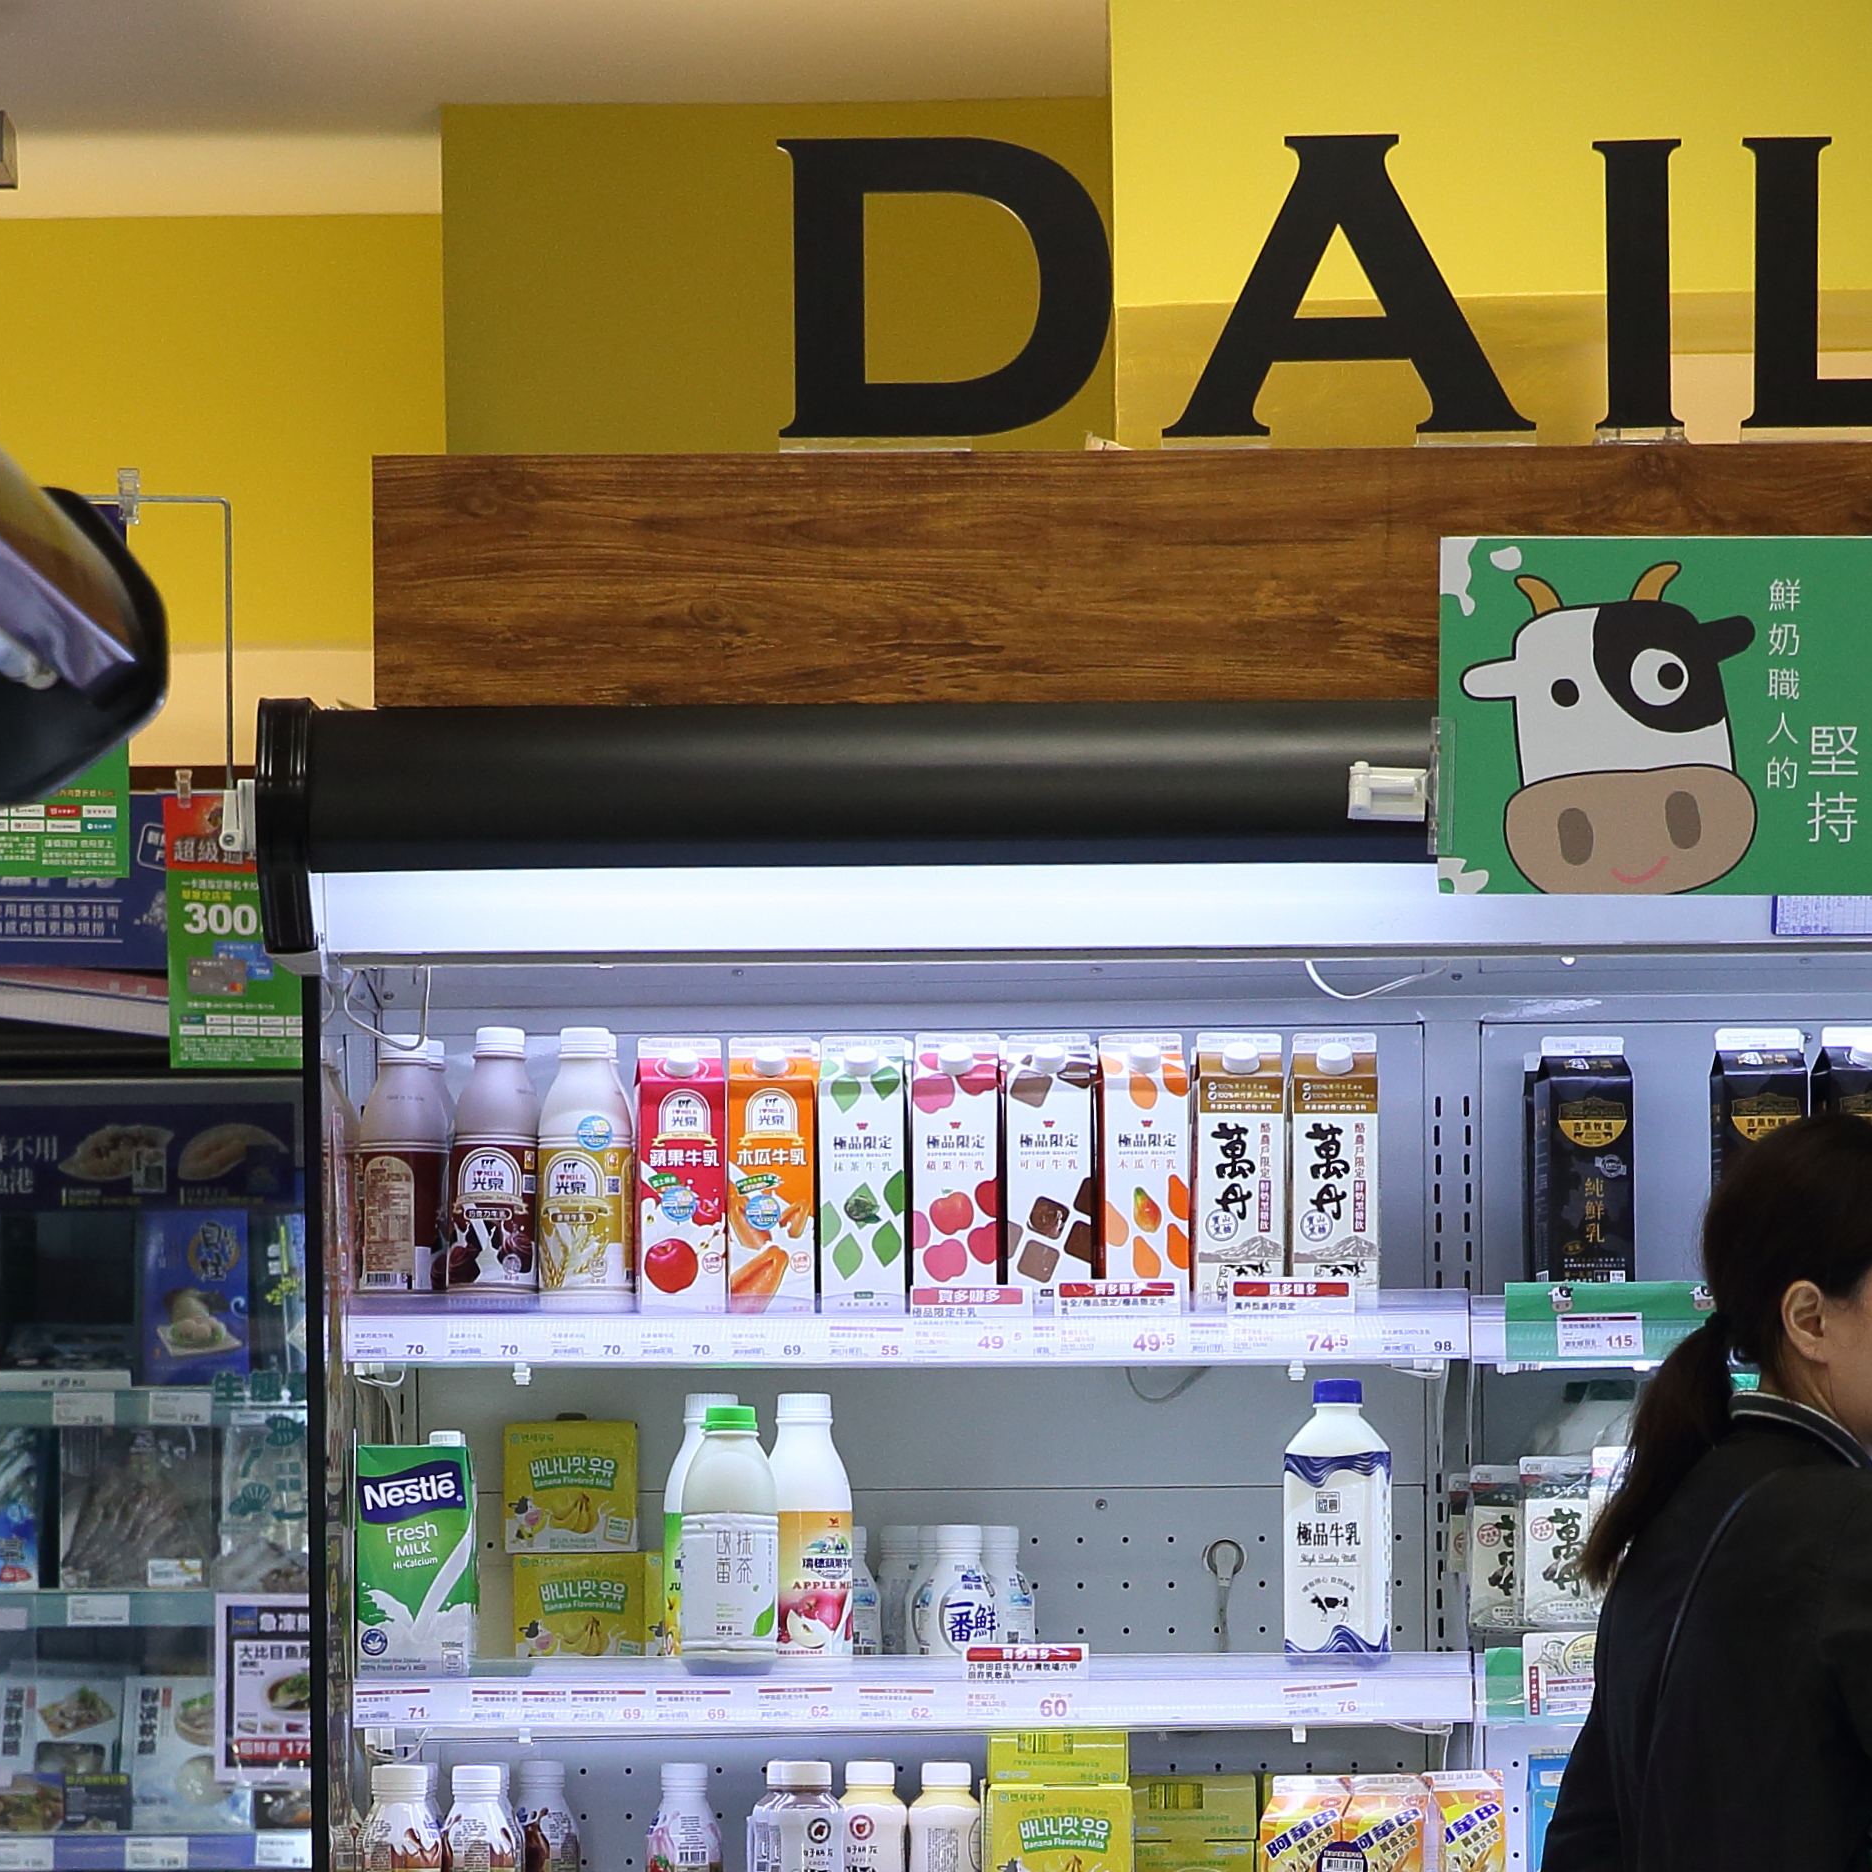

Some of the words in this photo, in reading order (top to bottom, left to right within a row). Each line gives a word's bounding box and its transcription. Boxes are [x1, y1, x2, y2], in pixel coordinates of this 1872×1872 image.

[1766, 577, 1801, 791] 鮮奶職人的
[1806, 724, 1861, 845] 堅持
[183, 902, 257, 935] 300
[833, 1135, 893, 1151] 極品限定
[926, 1134, 985, 1150] 極品限定
[1019, 1133, 1079, 1150] 極品限定
[1117, 1132, 1177, 1149] 極品限定
[649, 1149, 720, 1168] 蘋果牛乳
[736, 1148, 807, 1167] 木瓜牛乳
[1211, 1123, 1255, 1220] 萬丹
[1305, 1123, 1350, 1220] 萬丹
[472, 1178, 504, 1191] 光泉
[1585, 1177, 1605, 1243] 純鮮乳
[406, 1344, 424, 1356] 70
[500, 1344, 519, 1356] 70
[603, 1344, 621, 1356] 70
[783, 1344, 801, 1356] 69
[881, 1344, 899, 1356] 55
[1133, 1334, 1175, 1352] 49.5
[1307, 1334, 1349, 1352] 74.5
[1434, 1340, 1452, 1352] 98
[1606, 1335, 1633, 1348] 115
[530, 1458, 587, 1478] 바나나맛
[588, 1457, 618, 1477] 우유
[364, 1472, 457, 1511] Nestlé
[386, 1521, 438, 1542] Fresh
[1295, 1521, 1361, 1546] 極品牛乳
[395, 1542, 432, 1557] MILK
[736, 1530, 753, 1584] 抹茶
[393, 1556, 438, 1570] Hi-Calcium
[539, 1582, 597, 1601] 바나나맛
[599, 1581, 626, 1600] 우유
[407, 1708, 426, 1719] 71
[623, 1708, 641, 1719] 69
[707, 1708, 725, 1719] 69
[811, 1706, 829, 1717] 62
[911, 1707, 929, 1719] 62
[1039, 1700, 1068, 1718] 60
[1338, 1701, 1357, 1713] 76
[1020, 1818, 1078, 1840] 바나나맛
[1080, 1821, 1109, 1839] 우유
[1266, 1808, 1339, 1861] 阿華田
[1024, 1839, 1050, 1850] Banana
[1052, 1840, 1087, 1851] Flavored
[1088, 1841, 1104, 1851] Milk
